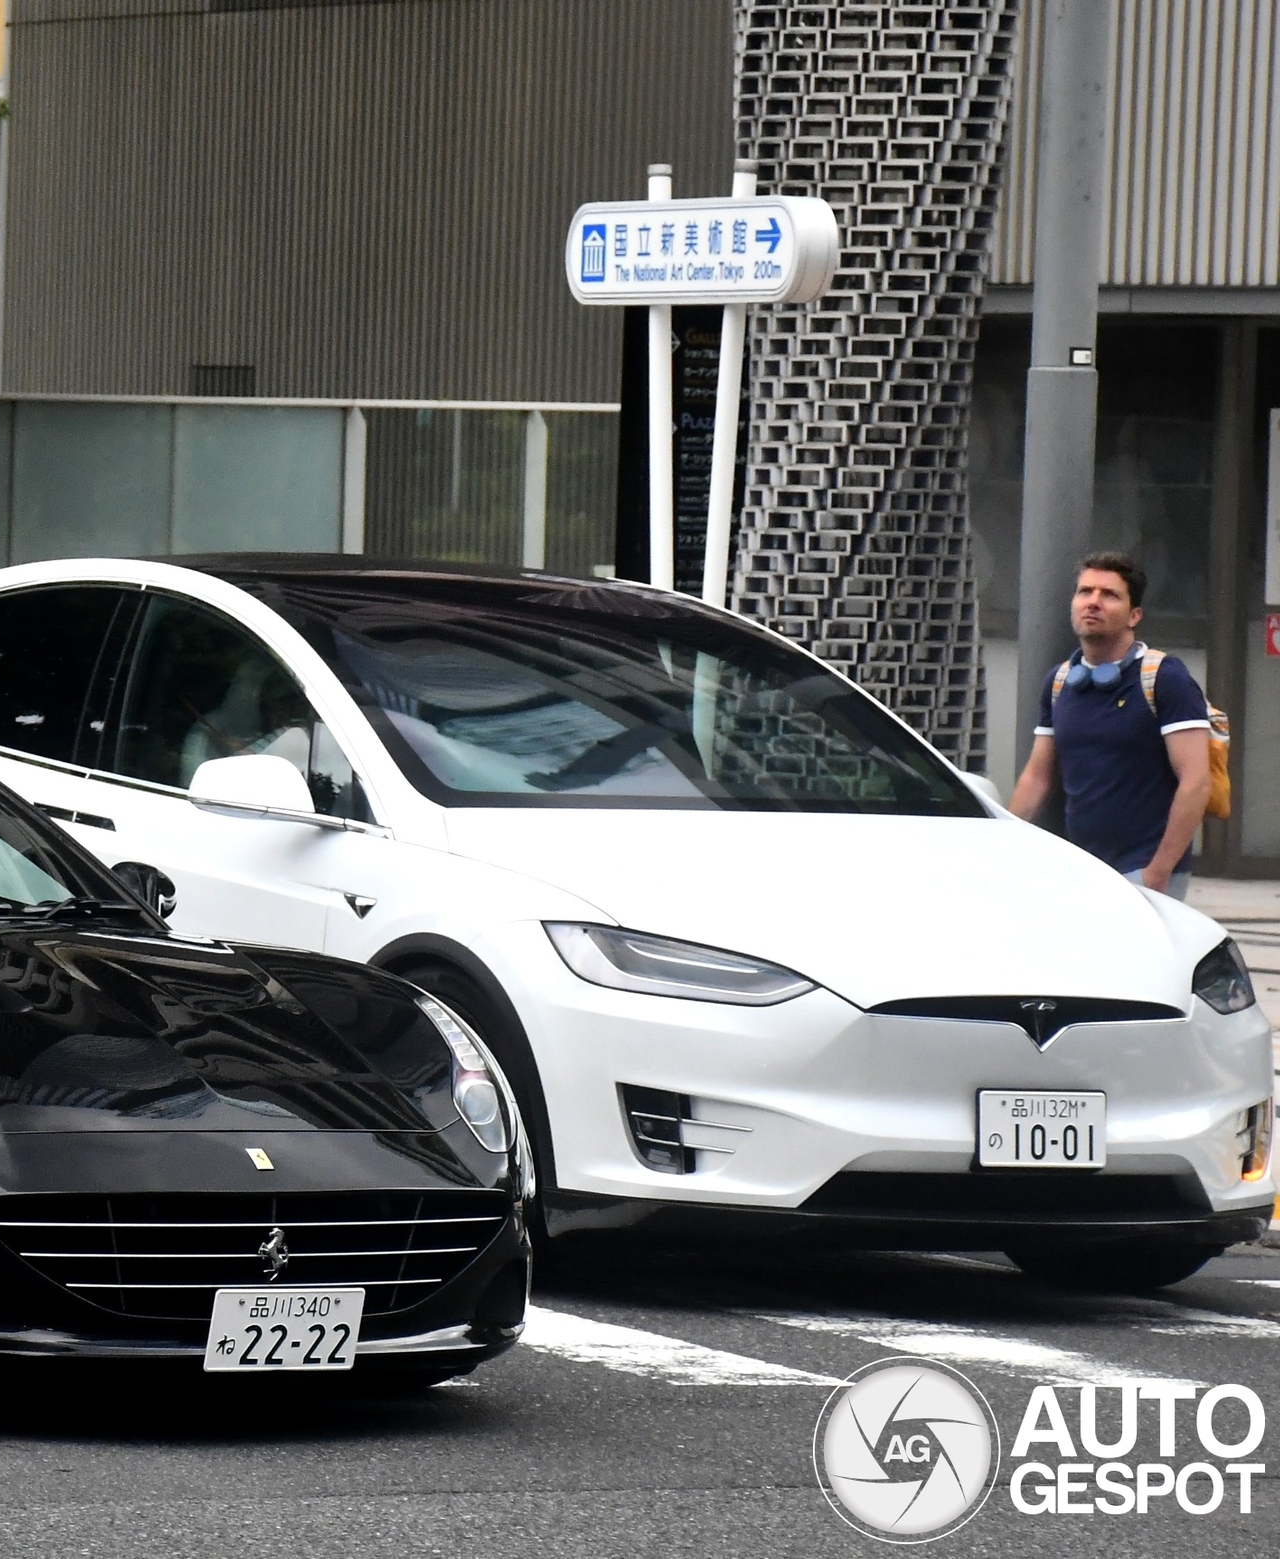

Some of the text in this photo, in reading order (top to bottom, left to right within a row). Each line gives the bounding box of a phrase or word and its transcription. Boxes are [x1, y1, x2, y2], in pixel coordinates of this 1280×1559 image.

[615, 220, 747, 257] 国立新美術館
[615, 264, 629, 281] The
[633, 263, 667, 281] National
[670, 263, 683, 280] Art
[754, 260, 781, 279] 200m
[988, 1123, 1094, 1161] の 10-01
[216, 1324, 351, 1365] ね 22-22
